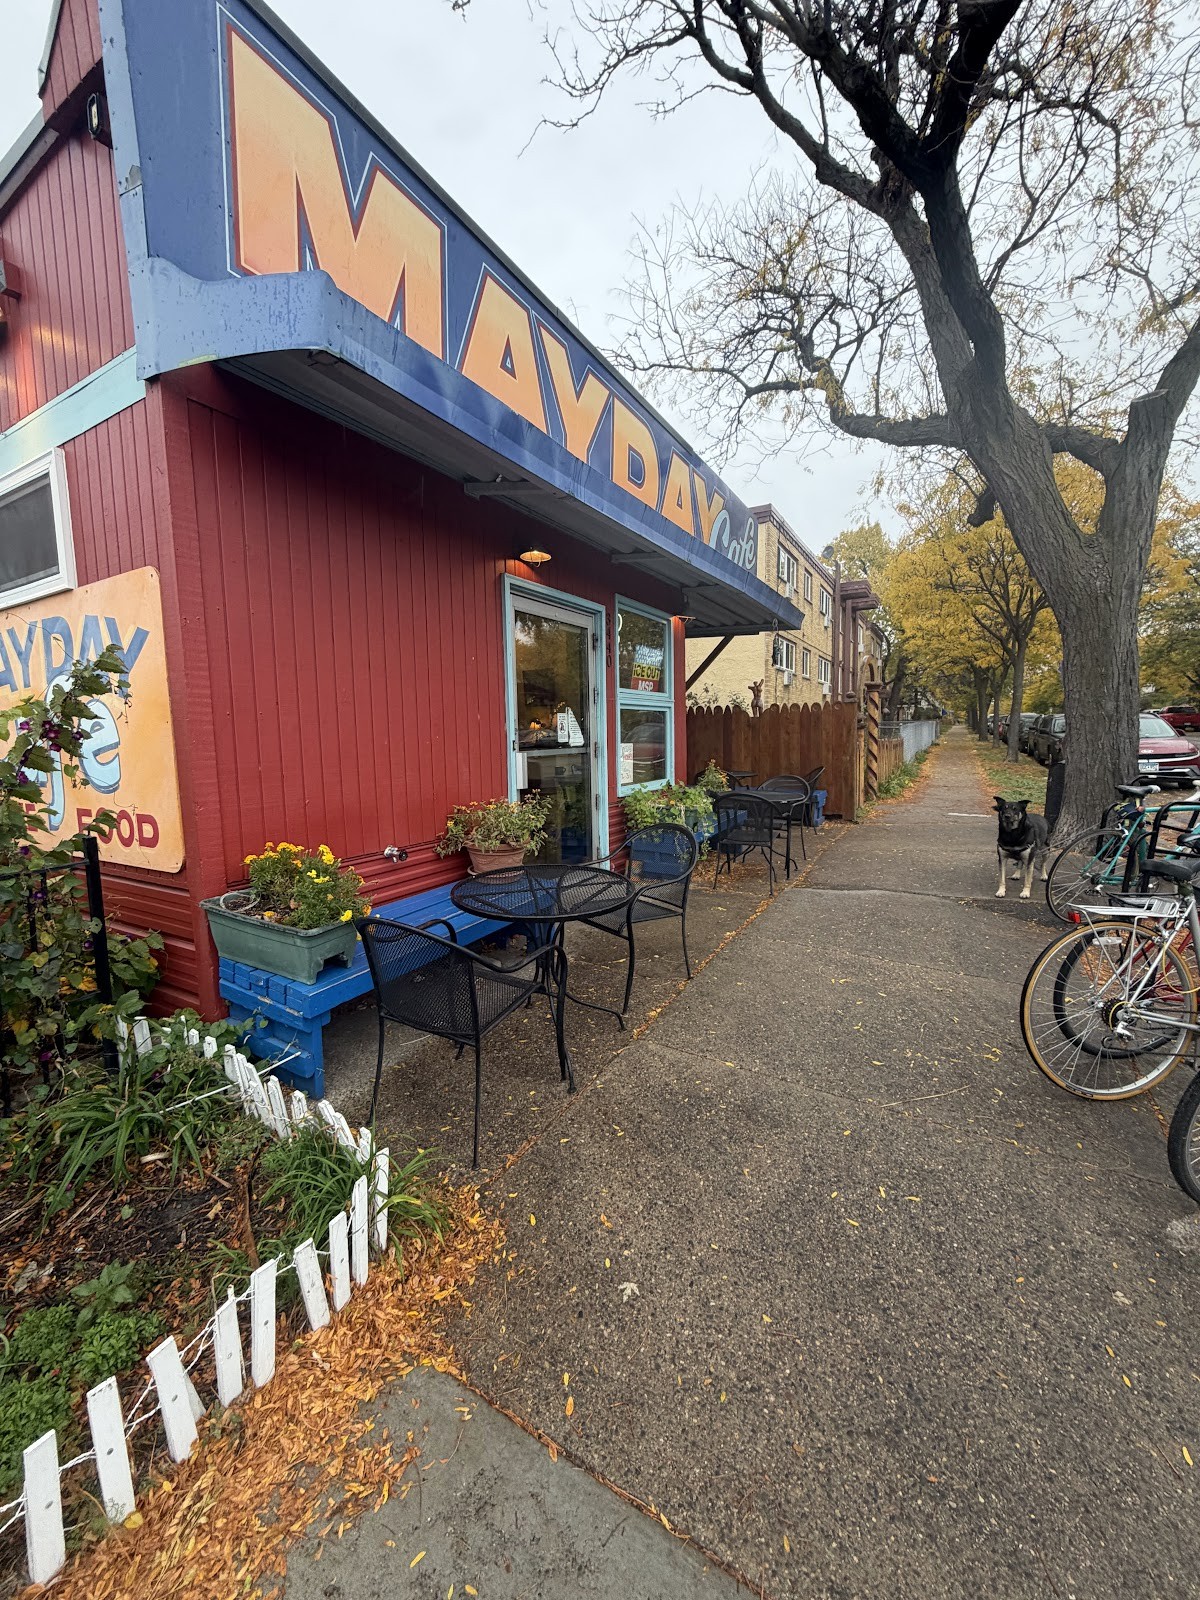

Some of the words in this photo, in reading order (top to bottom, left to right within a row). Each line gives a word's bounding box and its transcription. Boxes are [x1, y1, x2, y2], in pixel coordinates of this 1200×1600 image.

[227, 22, 726, 546] MAYDAY
[633, 664, 646, 678] ICE
[646, 666, 660, 680] OUT
[638, 680, 654, 692] MSP
